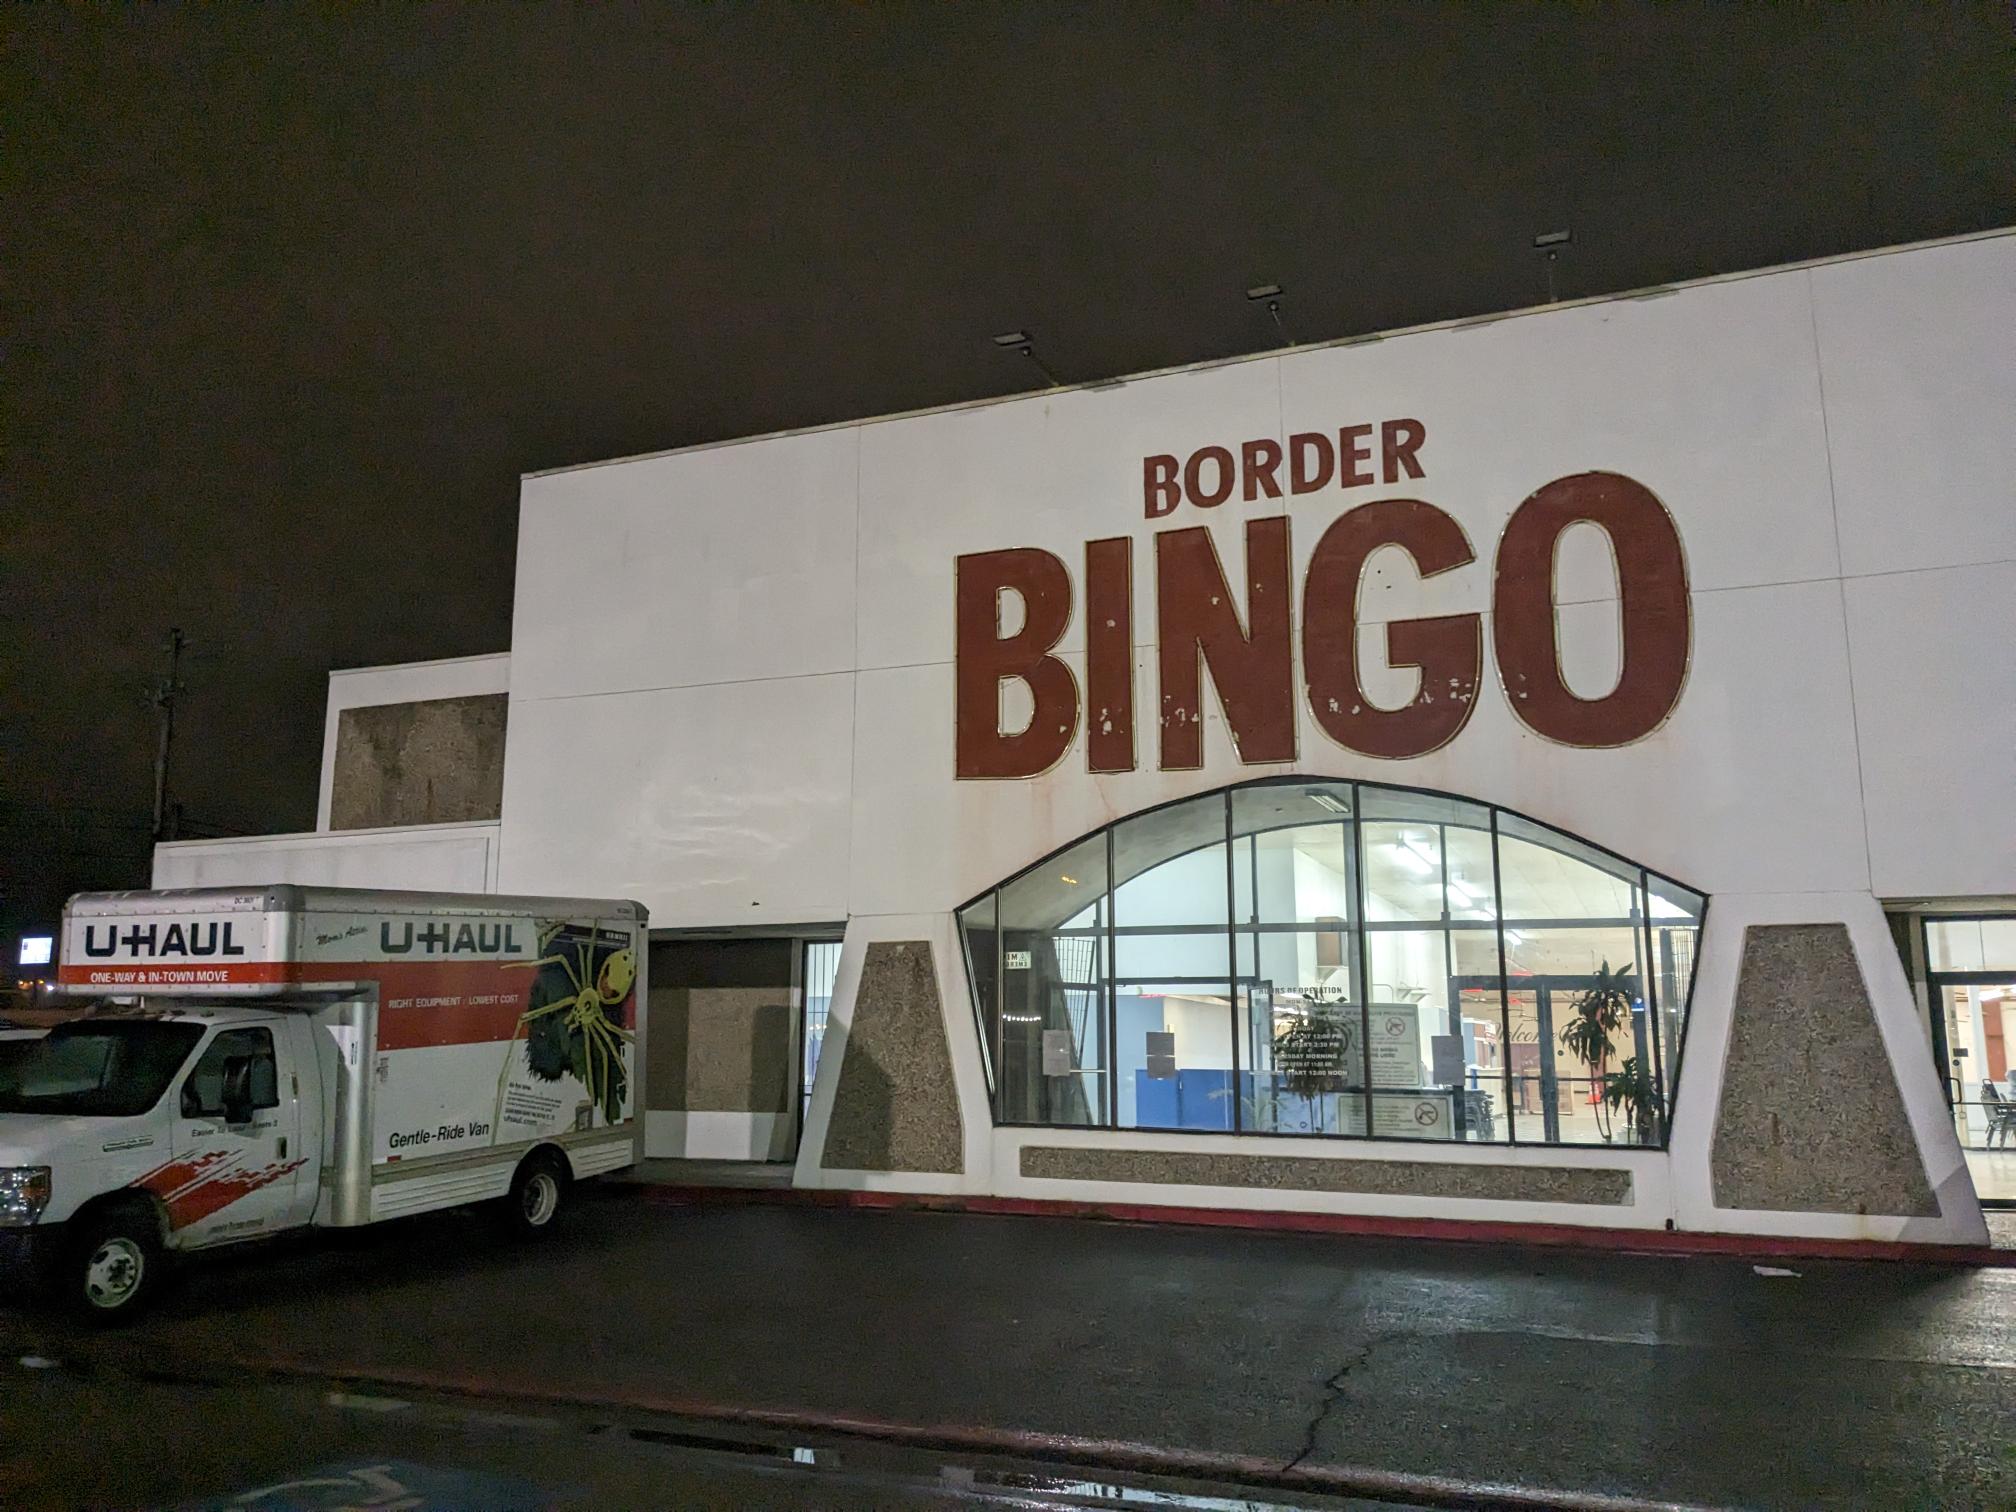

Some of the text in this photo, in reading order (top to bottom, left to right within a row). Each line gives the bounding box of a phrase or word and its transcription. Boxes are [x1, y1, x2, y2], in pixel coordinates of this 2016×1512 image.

[1144, 418, 1426, 519] BORDER
[954, 470, 1693, 780] BINGO
[85, 921, 245, 957] U-HAUL
[380, 921, 522, 954] U-HAUL
[90, 970, 229, 983] ONE-WAY & IN-TOWN MOVE
[388, 994, 519, 1009] RIGHT EQUIPMENT LOWEST COST
[389, 1122, 490, 1148] Gentle-Ride Van
